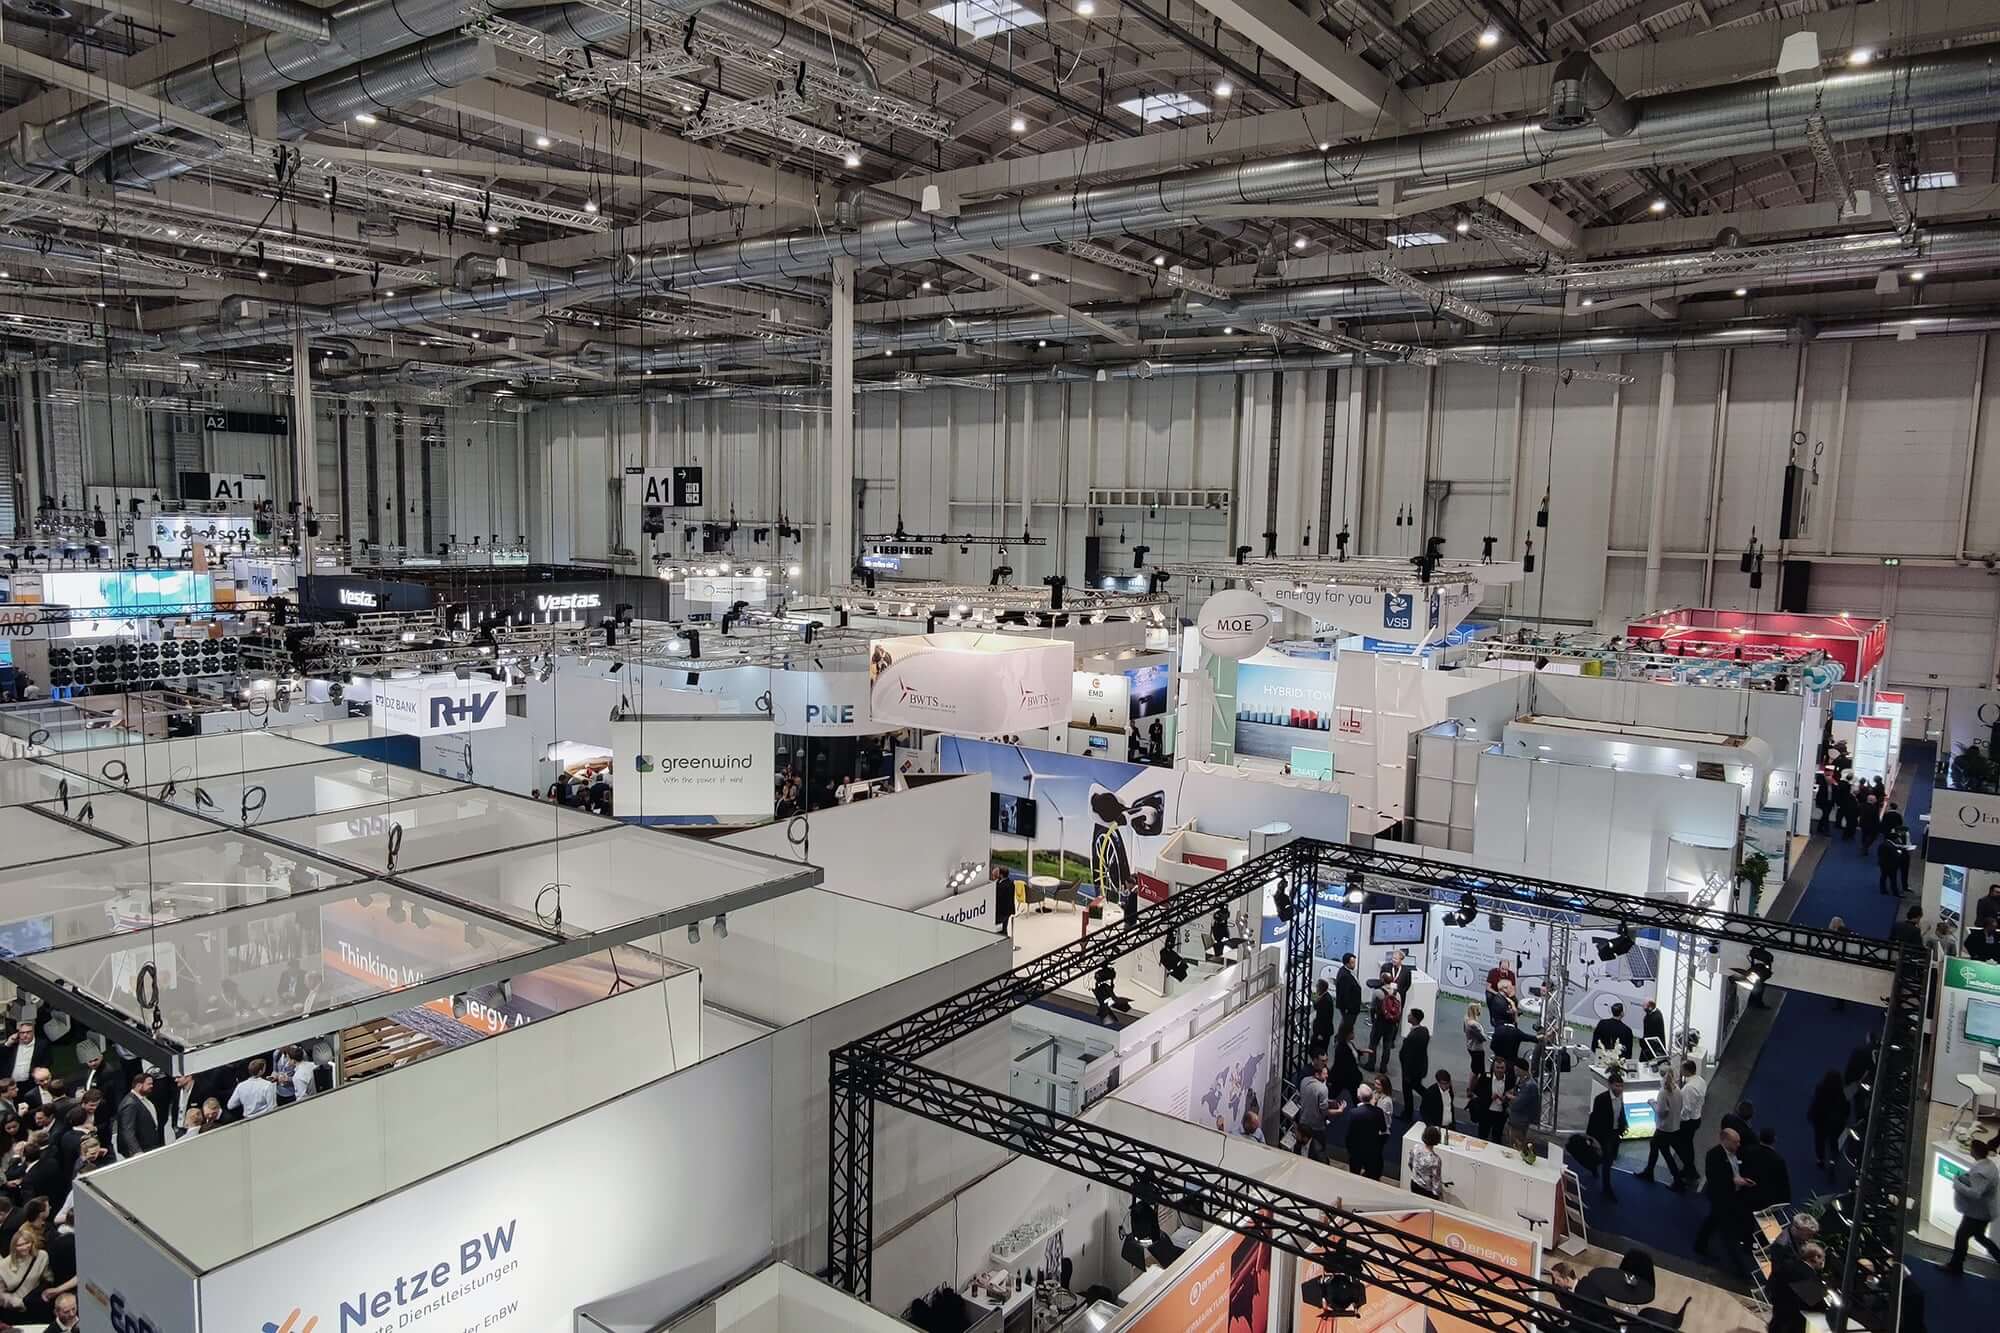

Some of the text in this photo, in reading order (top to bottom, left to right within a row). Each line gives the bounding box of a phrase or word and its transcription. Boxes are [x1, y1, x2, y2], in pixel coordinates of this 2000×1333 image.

[207, 416, 225, 429] A2
[214, 479, 244, 499] A1
[644, 476, 669, 503] A1
[872, 545, 934, 556] LIEBHERR
[1275, 589, 1372, 606] energy for you
[1385, 617, 1409, 628] VSB
[910, 693, 939, 707] BWTS
[1027, 693, 1049, 707] BWTS
[1088, 689, 1104, 698] EMD
[1263, 684, 1303, 699] HYBRID
[395, 699, 417, 714] BANK
[430, 690, 498, 729] R+V
[806, 704, 854, 724] PNE
[661, 754, 753, 774] greenwind
[1317, 890, 1346, 904] Syste
[338, 941, 399, 988] Thinking
[1467, 1243, 1518, 1267] enervis
[340, 1219, 517, 1333] Netze BW
[399, 1259, 519, 1329] Dienstleistungen
[484, 1300, 519, 1327] EnBW
